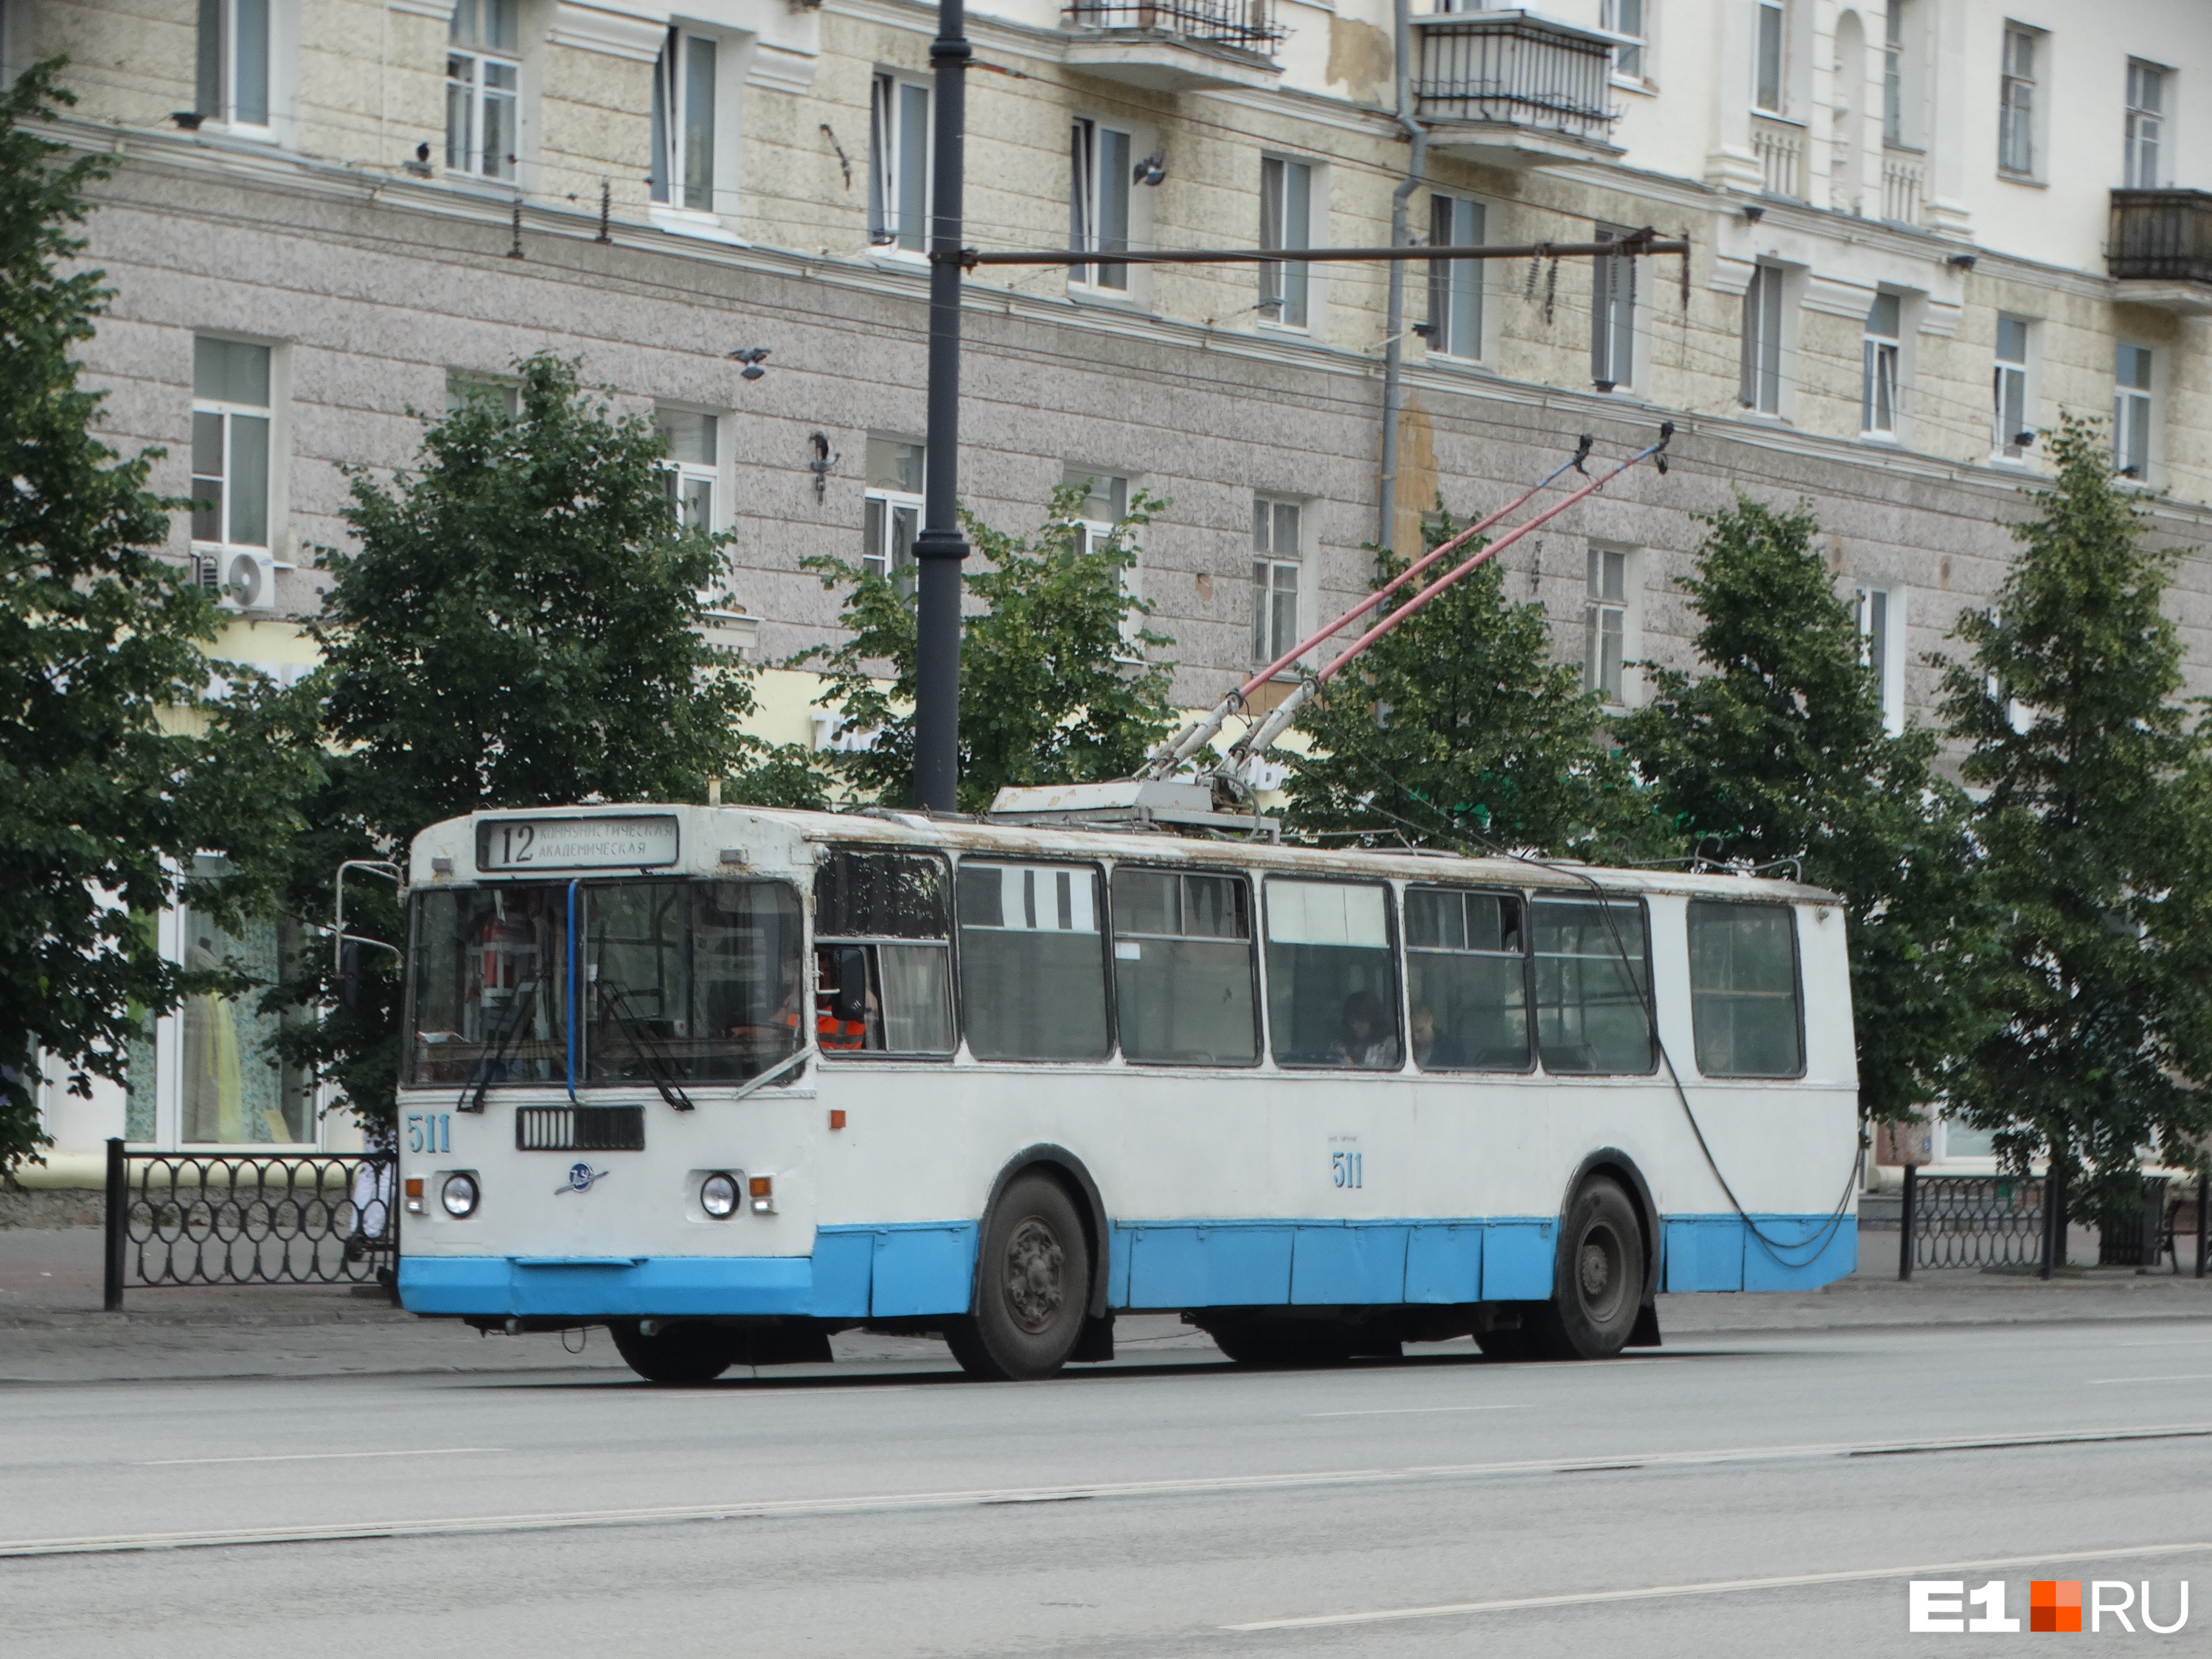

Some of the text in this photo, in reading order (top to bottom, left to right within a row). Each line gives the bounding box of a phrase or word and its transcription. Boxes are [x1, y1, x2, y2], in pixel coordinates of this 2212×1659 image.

[503, 824, 535, 865] 12
[538, 842, 647, 858] АКАДЕМИЧЕСКАЯ
[540, 823, 673, 840] КОММУНИСТИЧЕСКАЯ
[407, 1113, 451, 1153] 511
[1332, 1151, 1362, 1189] 511
